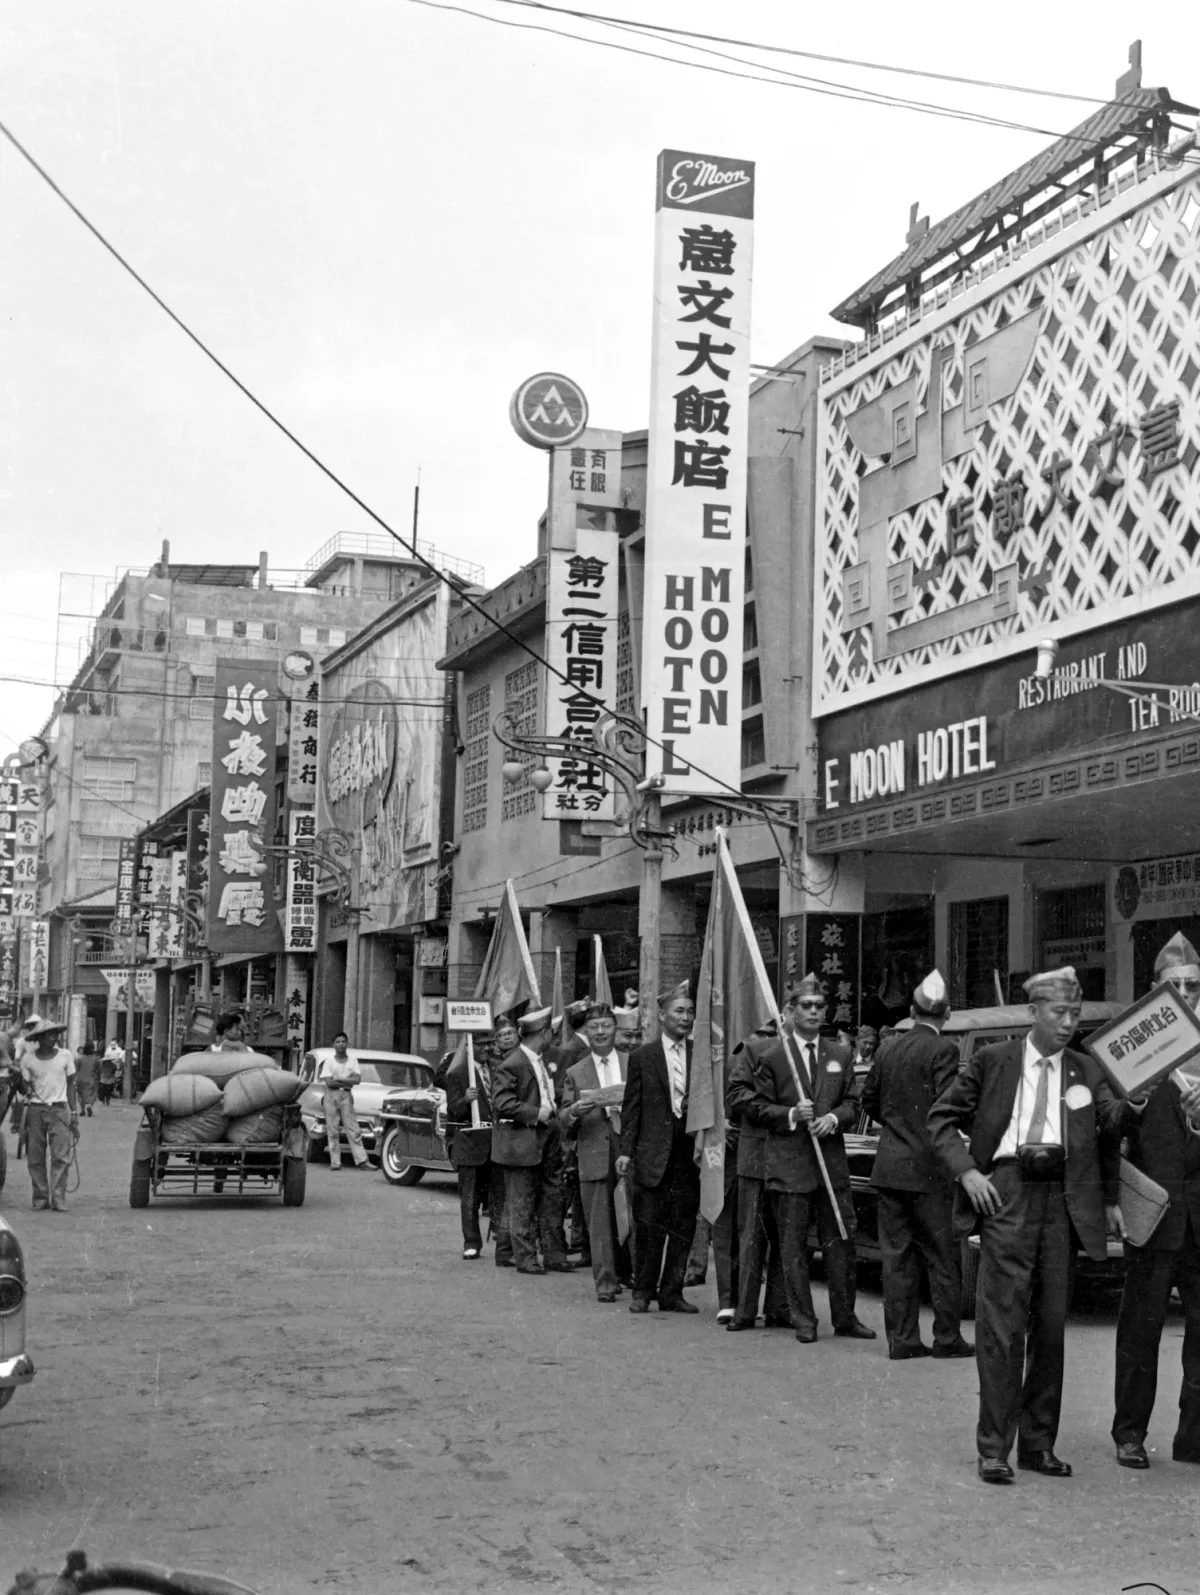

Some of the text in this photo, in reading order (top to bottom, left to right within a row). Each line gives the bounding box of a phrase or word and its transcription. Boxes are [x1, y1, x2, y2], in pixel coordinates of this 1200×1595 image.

[666, 160, 746, 200] E Moon
[672, 224, 737, 491] 意文大飯店
[698, 504, 732, 727] E MOON
[661, 574, 695, 777] HOTEL
[1018, 642, 1147, 711] RESTAURANT AND
[1129, 698, 1158, 732] TEA
[825, 715, 996, 808] E MOON HOTEL
